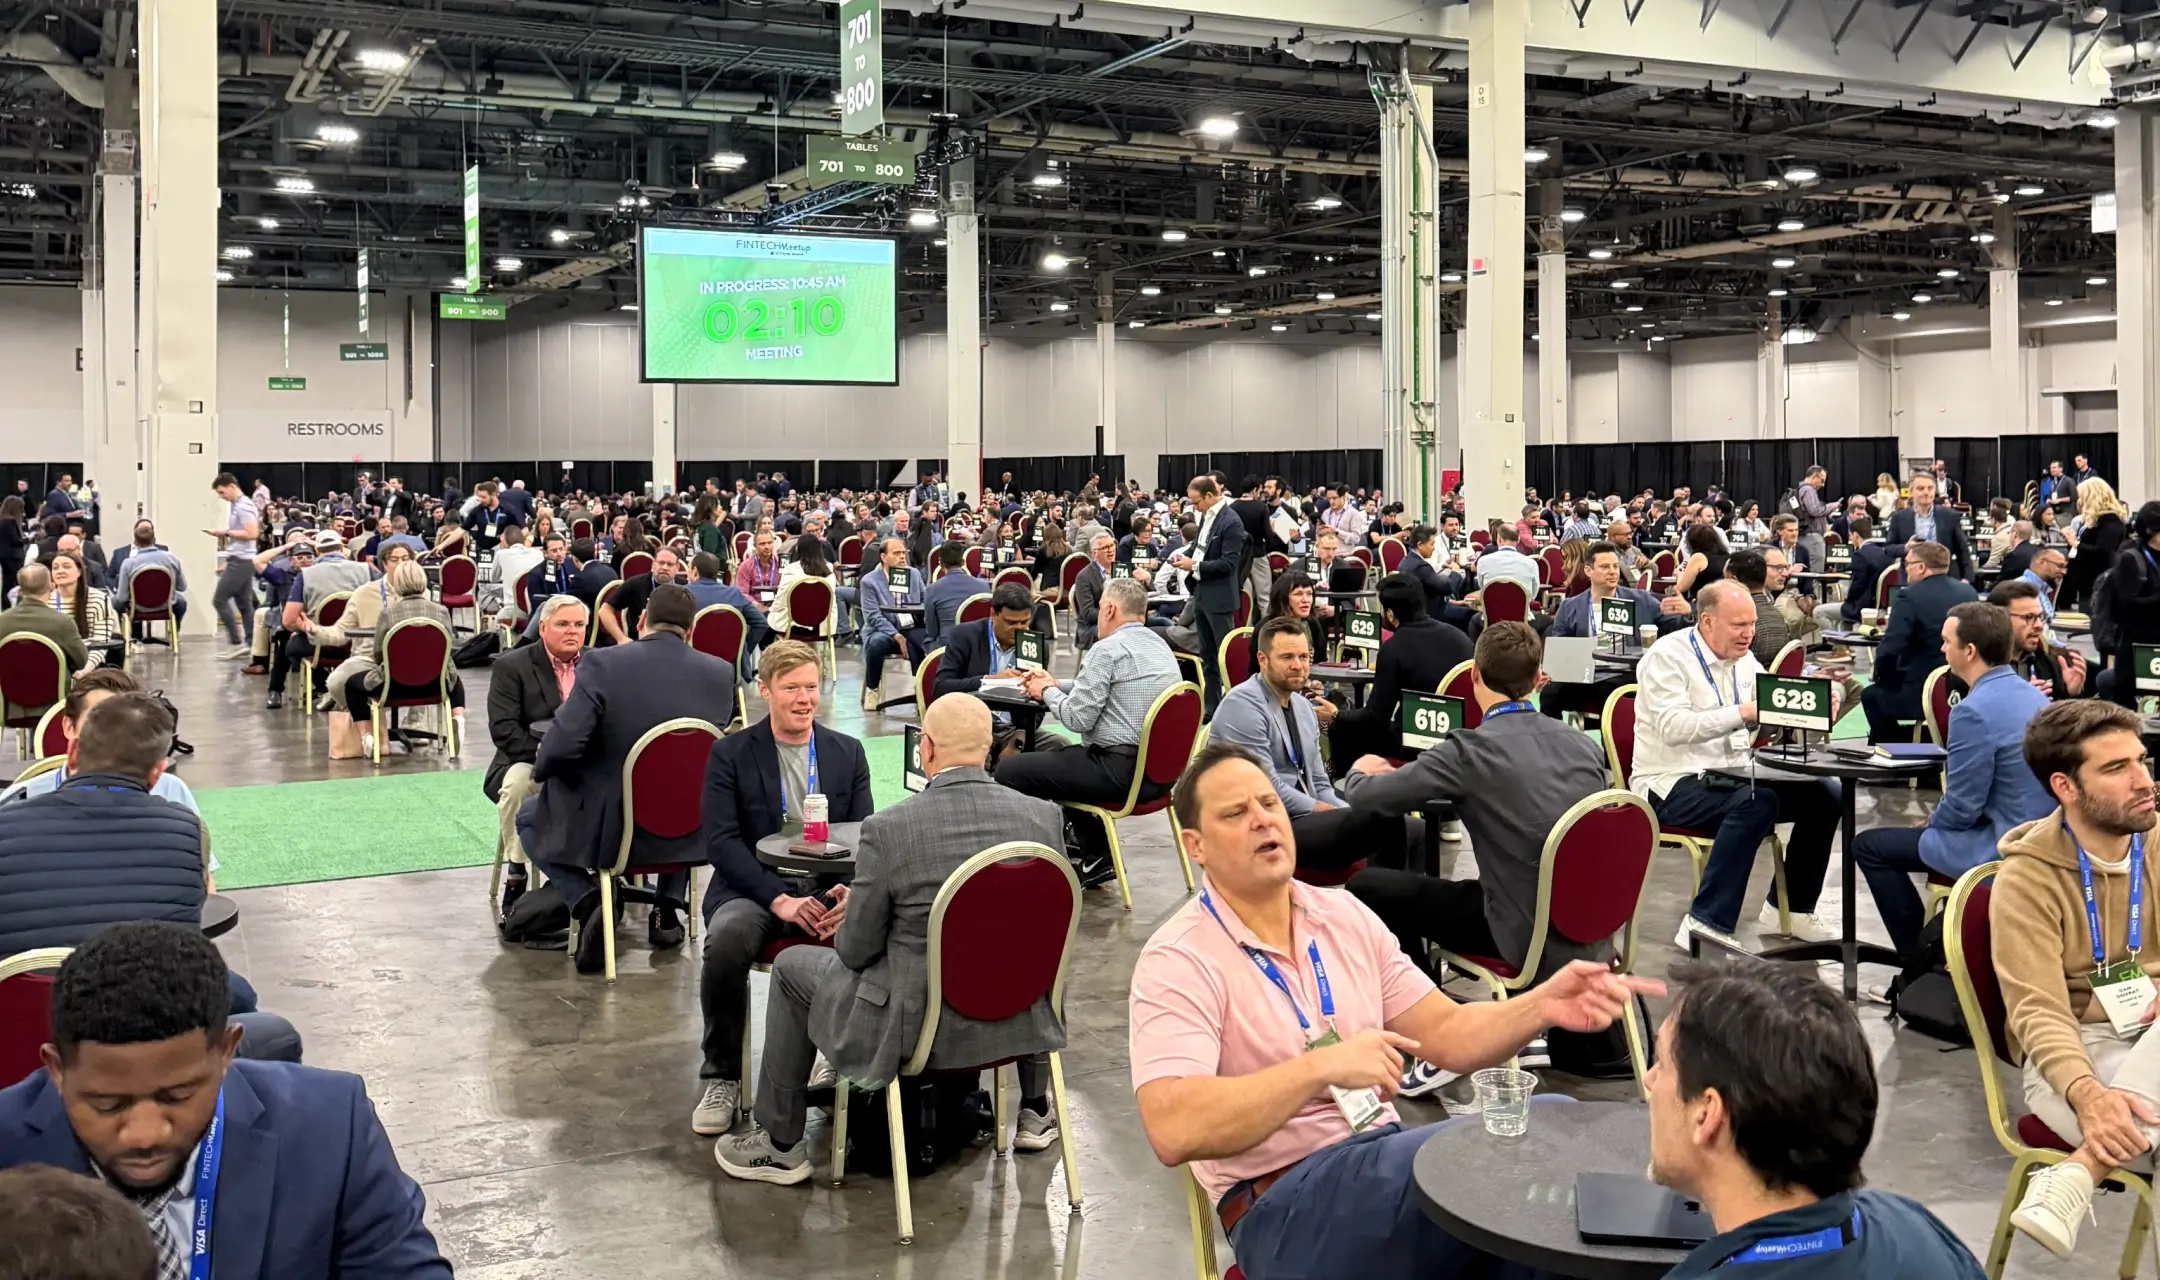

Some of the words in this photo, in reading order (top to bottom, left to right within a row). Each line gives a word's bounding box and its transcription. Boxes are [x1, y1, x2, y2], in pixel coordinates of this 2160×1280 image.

[848, 9, 872, 49] 701
[855, 54, 865, 71] TO
[846, 78, 875, 115] 800
[846, 142, 878, 153] TABLES
[819, 160, 844, 173] 701
[855, 165, 865, 173] TO
[875, 163, 904, 177] 800
[700, 282, 713, 294] IN
[717, 279, 789, 293] PROGRESS:
[792, 276, 823, 289] 10:45
[826, 275, 846, 288] AM
[481, 308, 499, 316] 900
[703, 295, 844, 343] 02:10
[746, 345, 803, 360] MEETING
[288, 423, 383, 437] RESTROOMS
[893, 574, 906, 585] 723
[1608, 607, 1629, 622] 630
[1351, 619, 1374, 636] 629
[1022, 640, 1037, 658] 618
[1772, 688, 1816, 711] 628
[1415, 708, 1450, 733] 619
[2131, 904, 2139, 918] VISA
[1254, 953, 1269, 970] VISA
[1314, 961, 1324, 977] VISA
[1320, 978, 1328, 996] Direct
[749, 1155, 772, 1168] HOKA
[197, 1199, 208, 1227] Direct
[195, 1229, 206, 1256] VISA
